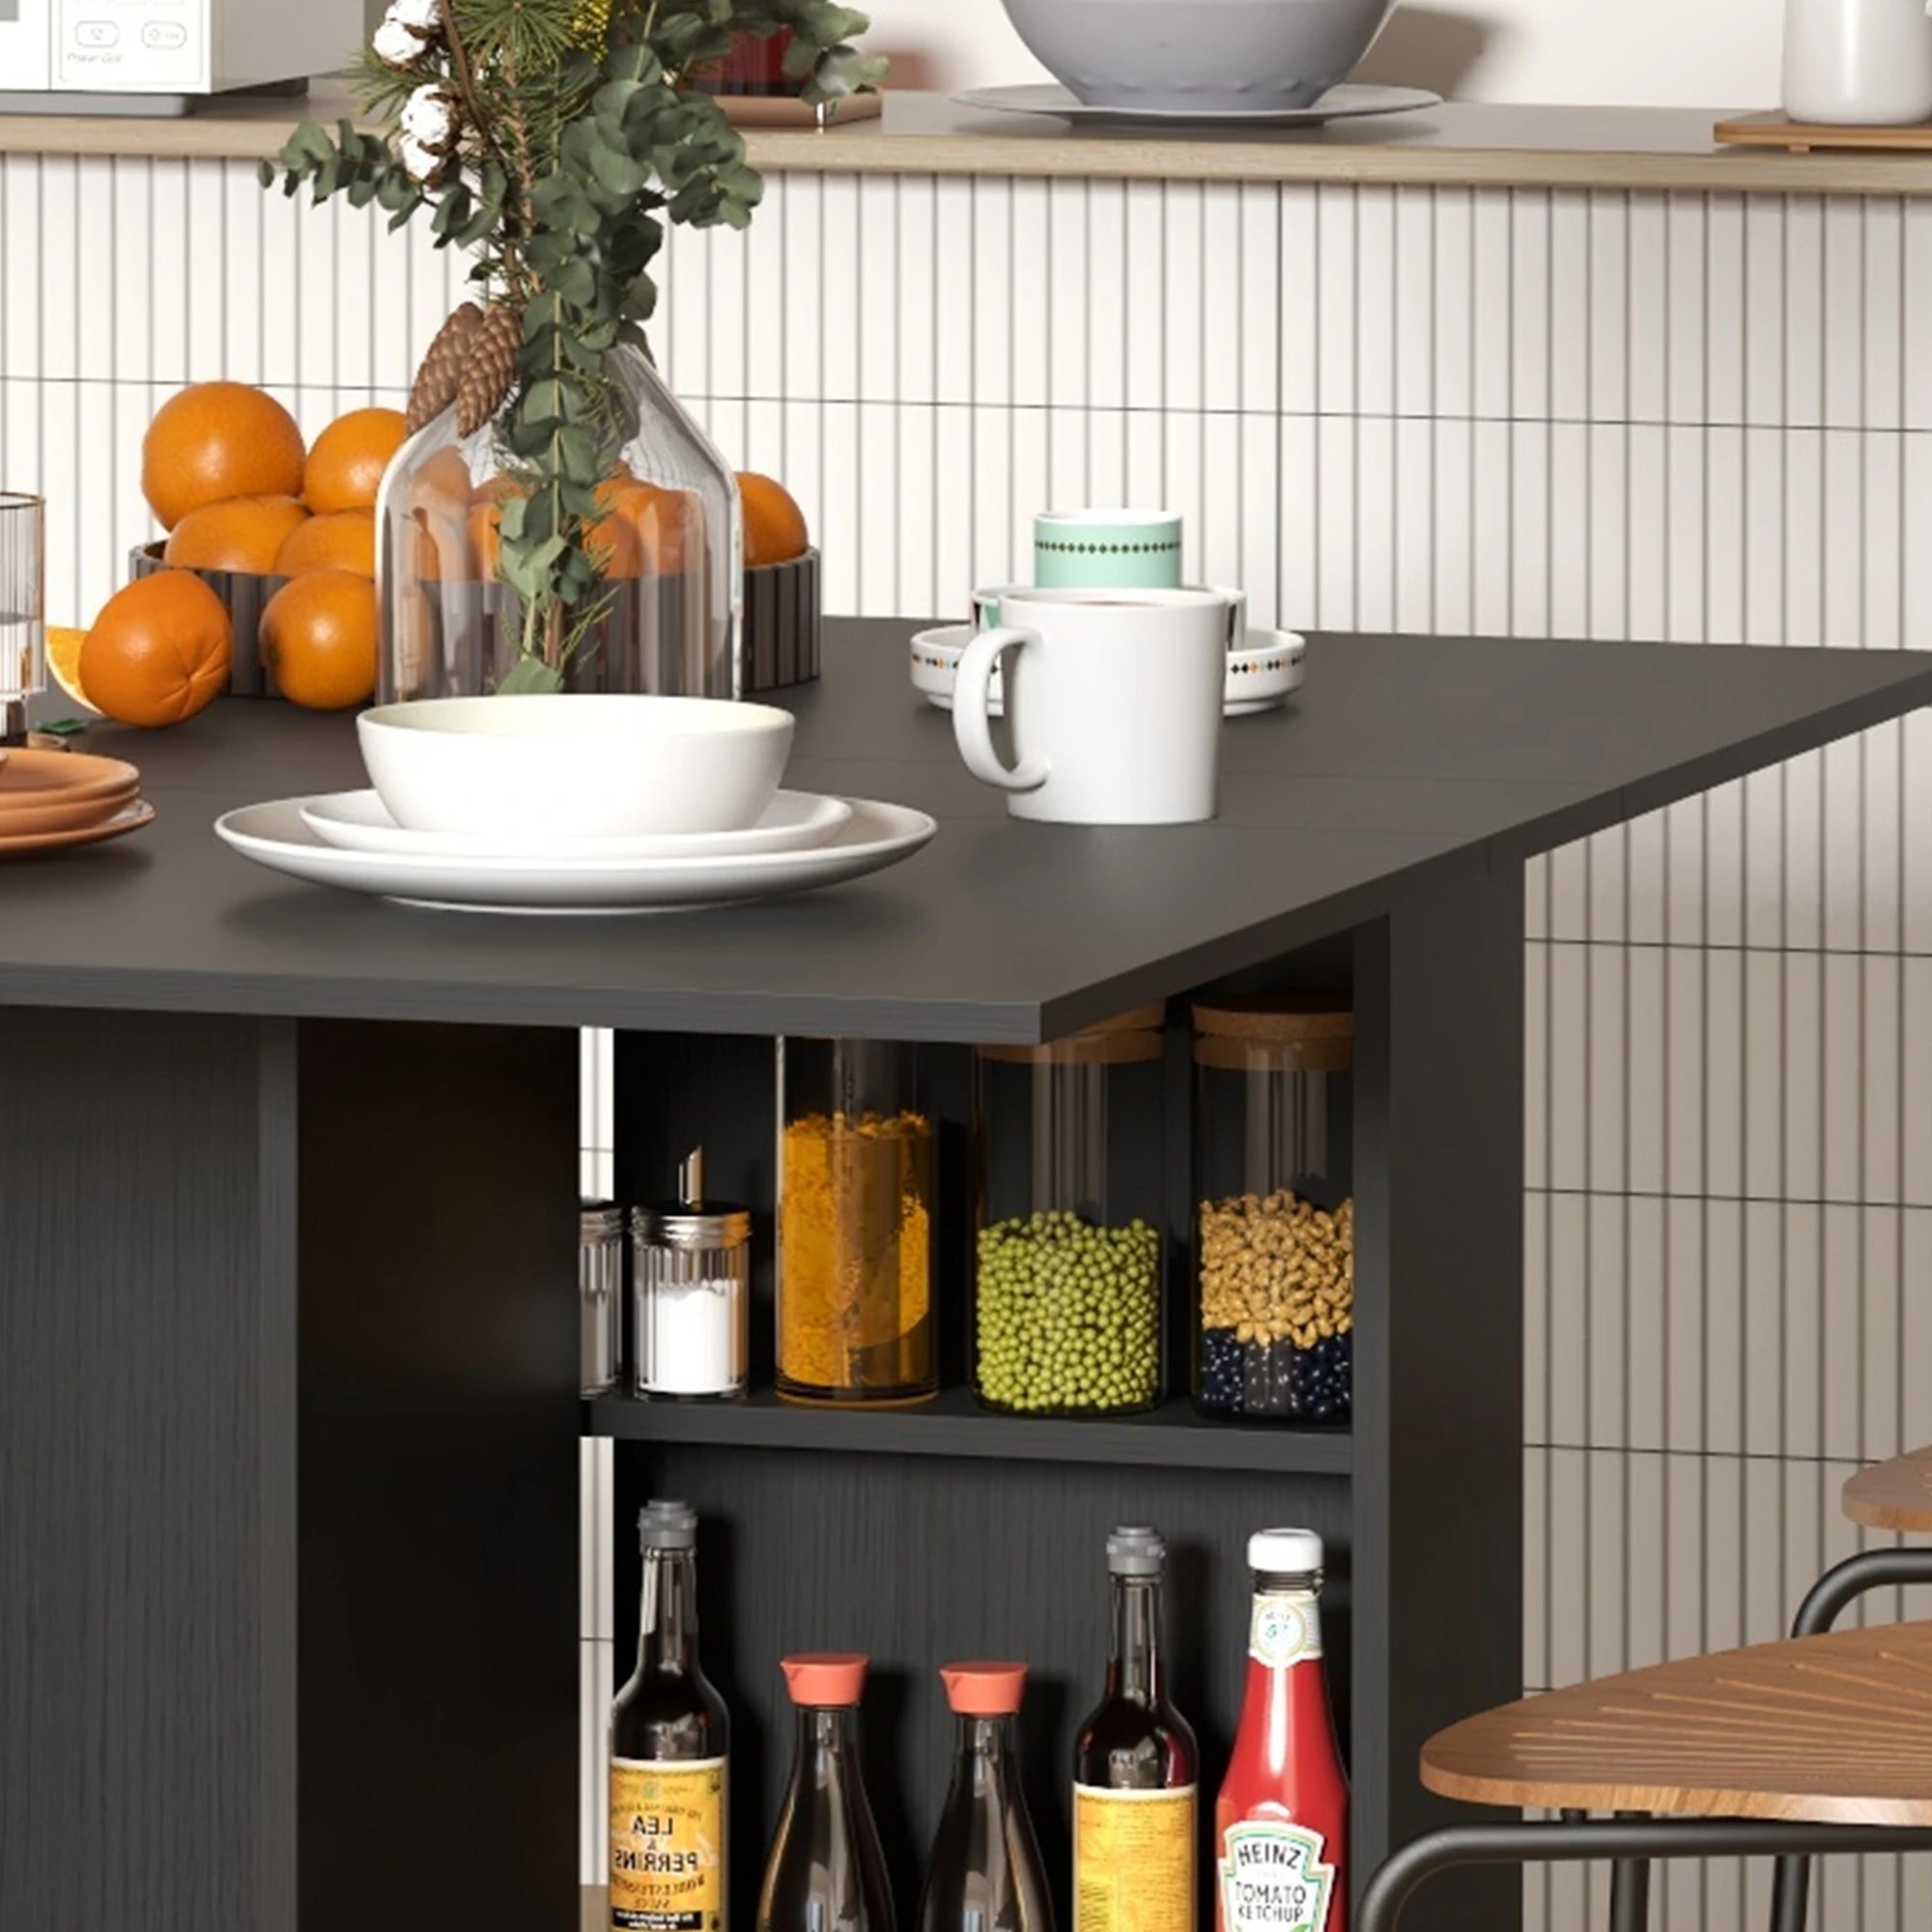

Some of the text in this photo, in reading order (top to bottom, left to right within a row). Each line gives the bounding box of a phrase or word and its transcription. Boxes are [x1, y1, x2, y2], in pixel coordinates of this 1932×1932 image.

[1238, 1841, 1301, 1869] HEINZ
[1236, 1881, 1307, 1905] TOMATO
[1238, 1905, 1304, 1922] KETCHUP
